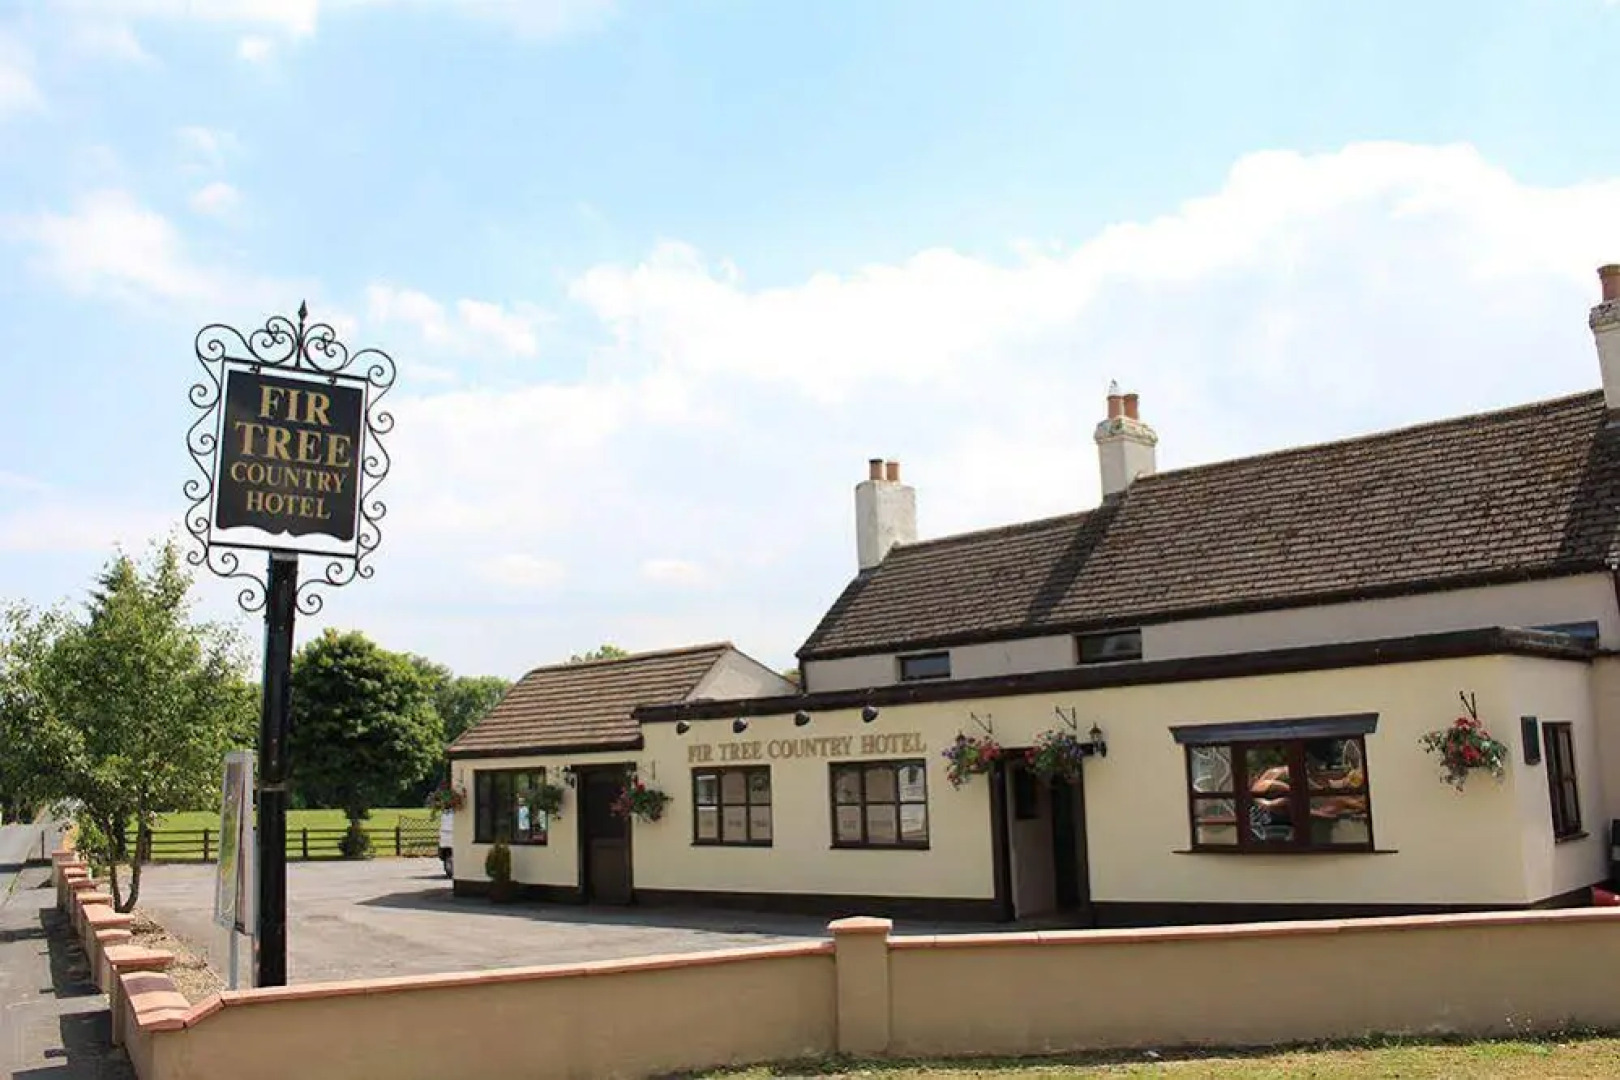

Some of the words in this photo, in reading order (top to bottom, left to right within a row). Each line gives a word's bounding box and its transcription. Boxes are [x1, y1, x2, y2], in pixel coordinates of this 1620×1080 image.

[259, 385, 331, 425] FIR
[235, 422, 350, 467] TREE
[231, 462, 346, 493] COUNTRY
[247, 491, 330, 519] HOTEL
[688, 745, 713, 763] FIR
[719, 743, 763, 761] TREE
[767, 736, 852, 759] COUNTRY
[862, 732, 927, 755] HOTEL
